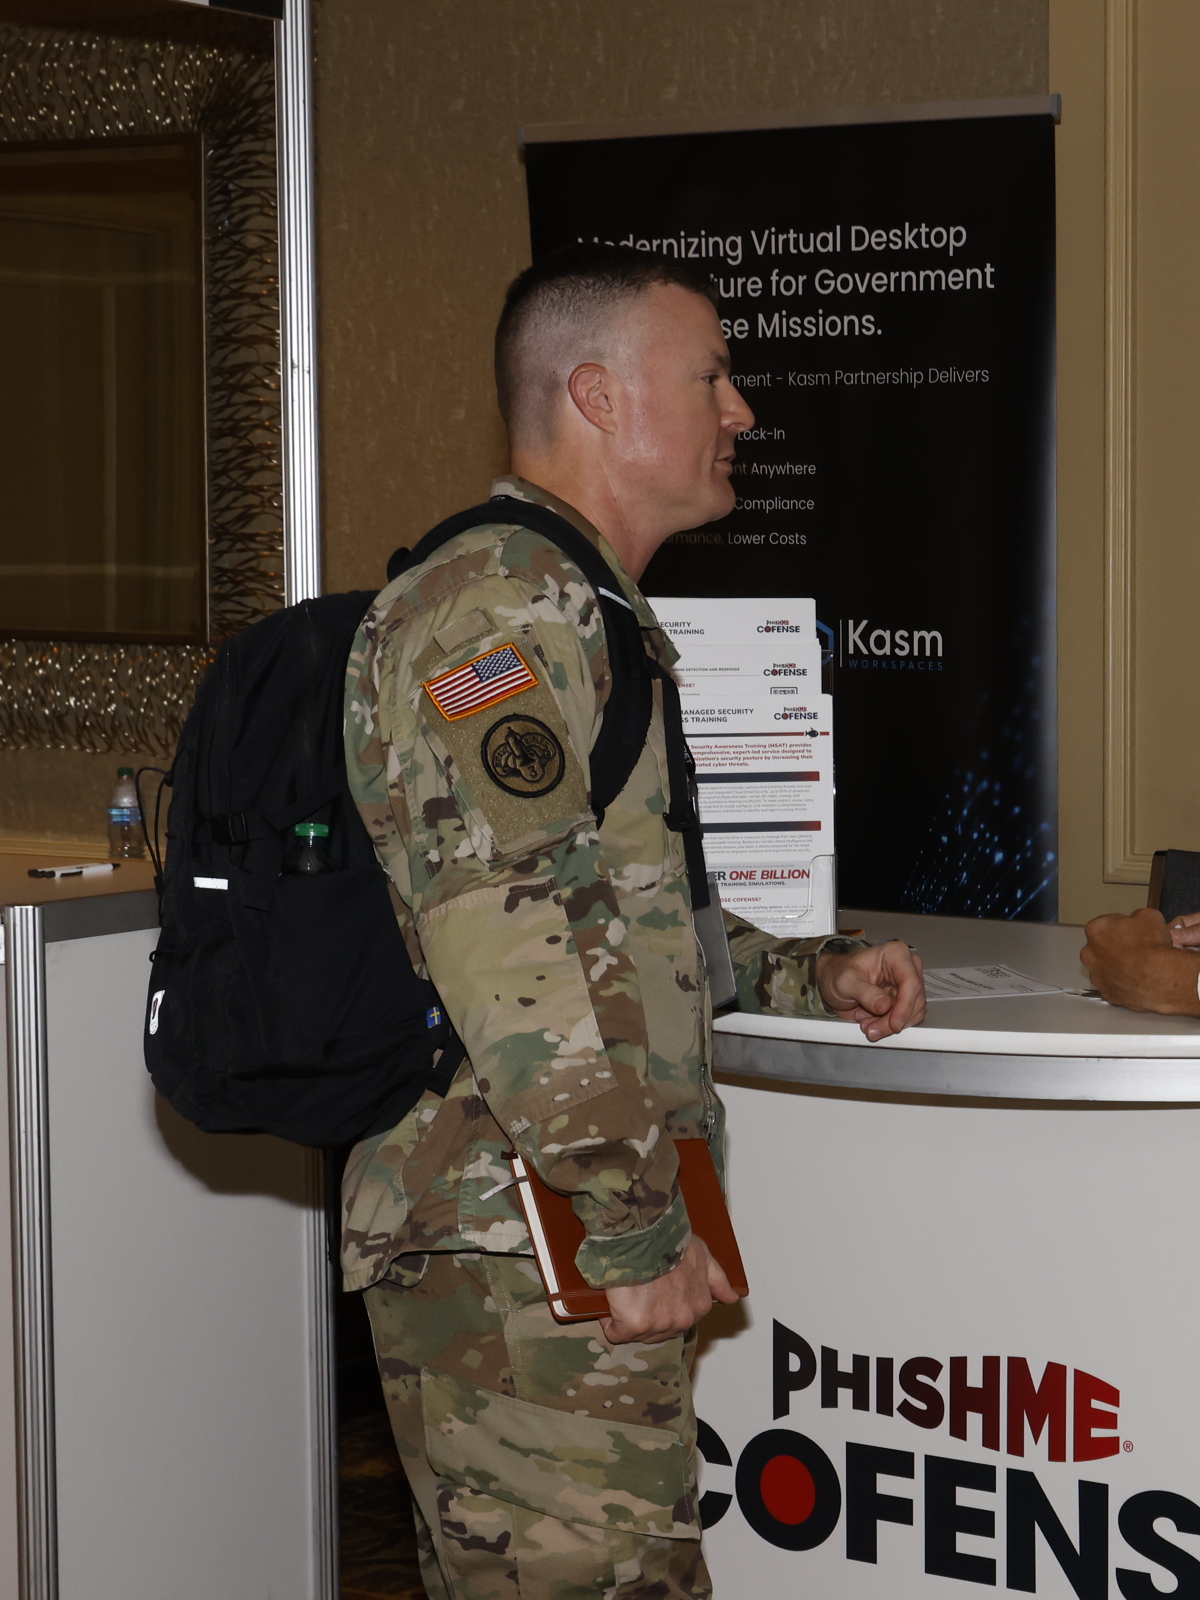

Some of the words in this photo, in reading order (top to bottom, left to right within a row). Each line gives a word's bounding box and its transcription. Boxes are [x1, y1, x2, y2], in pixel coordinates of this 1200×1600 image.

[751, 225, 841, 256] Virtual
[851, 222, 967, 256] Desktop
[770, 269, 807, 296] for
[814, 263, 995, 294] Government
[758, 310, 883, 338] Missions.
[789, 371, 830, 386] Kasm
[835, 367, 923, 388] Partnership
[928, 366, 989, 384] Delivers
[737, 427, 785, 440] Lock-In
[751, 462, 816, 478] Anywhere
[734, 497, 815, 513] Compliance
[728, 532, 766, 545] Lower
[769, 532, 807, 545] Costs
[848, 620, 943, 657] Kasm
[848, 660, 943, 670] WORKSPACES
[774, 712, 818, 720] COFENSE
[729, 870, 757, 880] ONE
[761, 869, 810, 880] BILLION
[772, 1317, 1120, 1462] PHISHME
